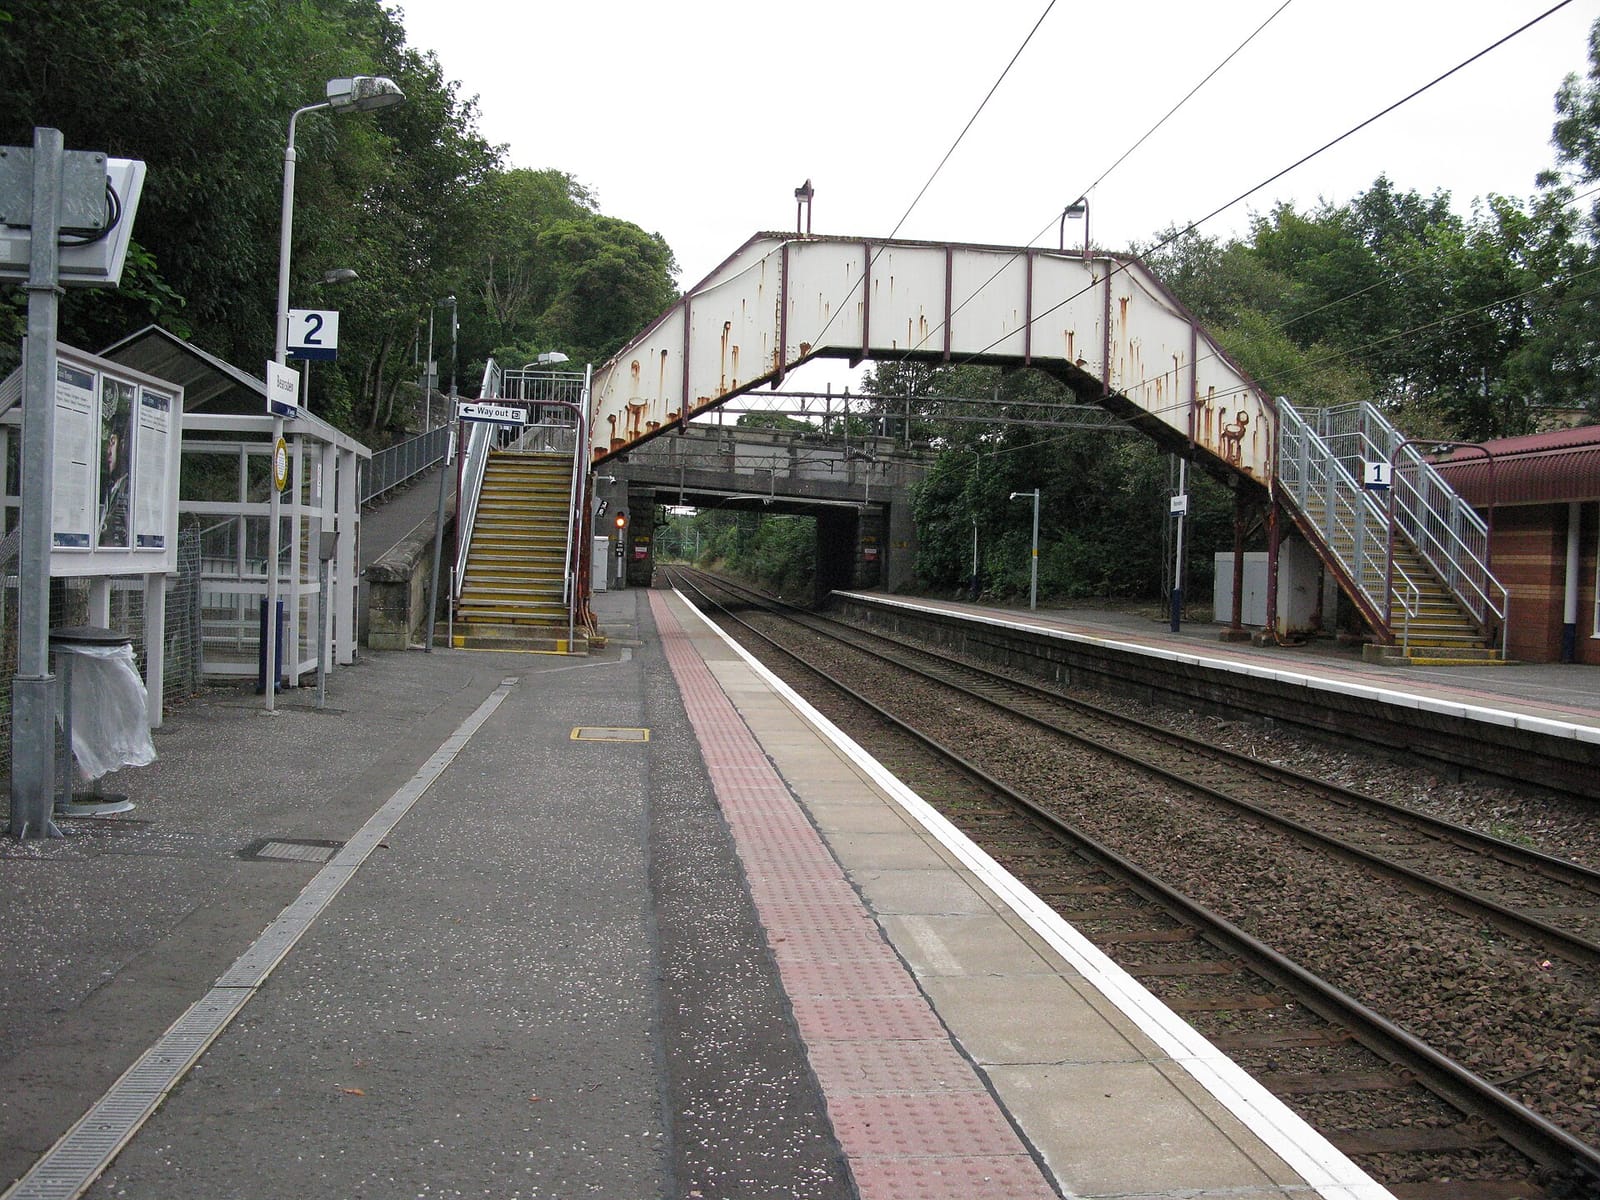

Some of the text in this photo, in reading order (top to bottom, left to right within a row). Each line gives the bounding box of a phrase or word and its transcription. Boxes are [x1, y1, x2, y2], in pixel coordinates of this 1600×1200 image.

[304, 313, 323, 345] 2
[477, 406, 494, 417] Way
[1373, 464, 1383, 482] 1
